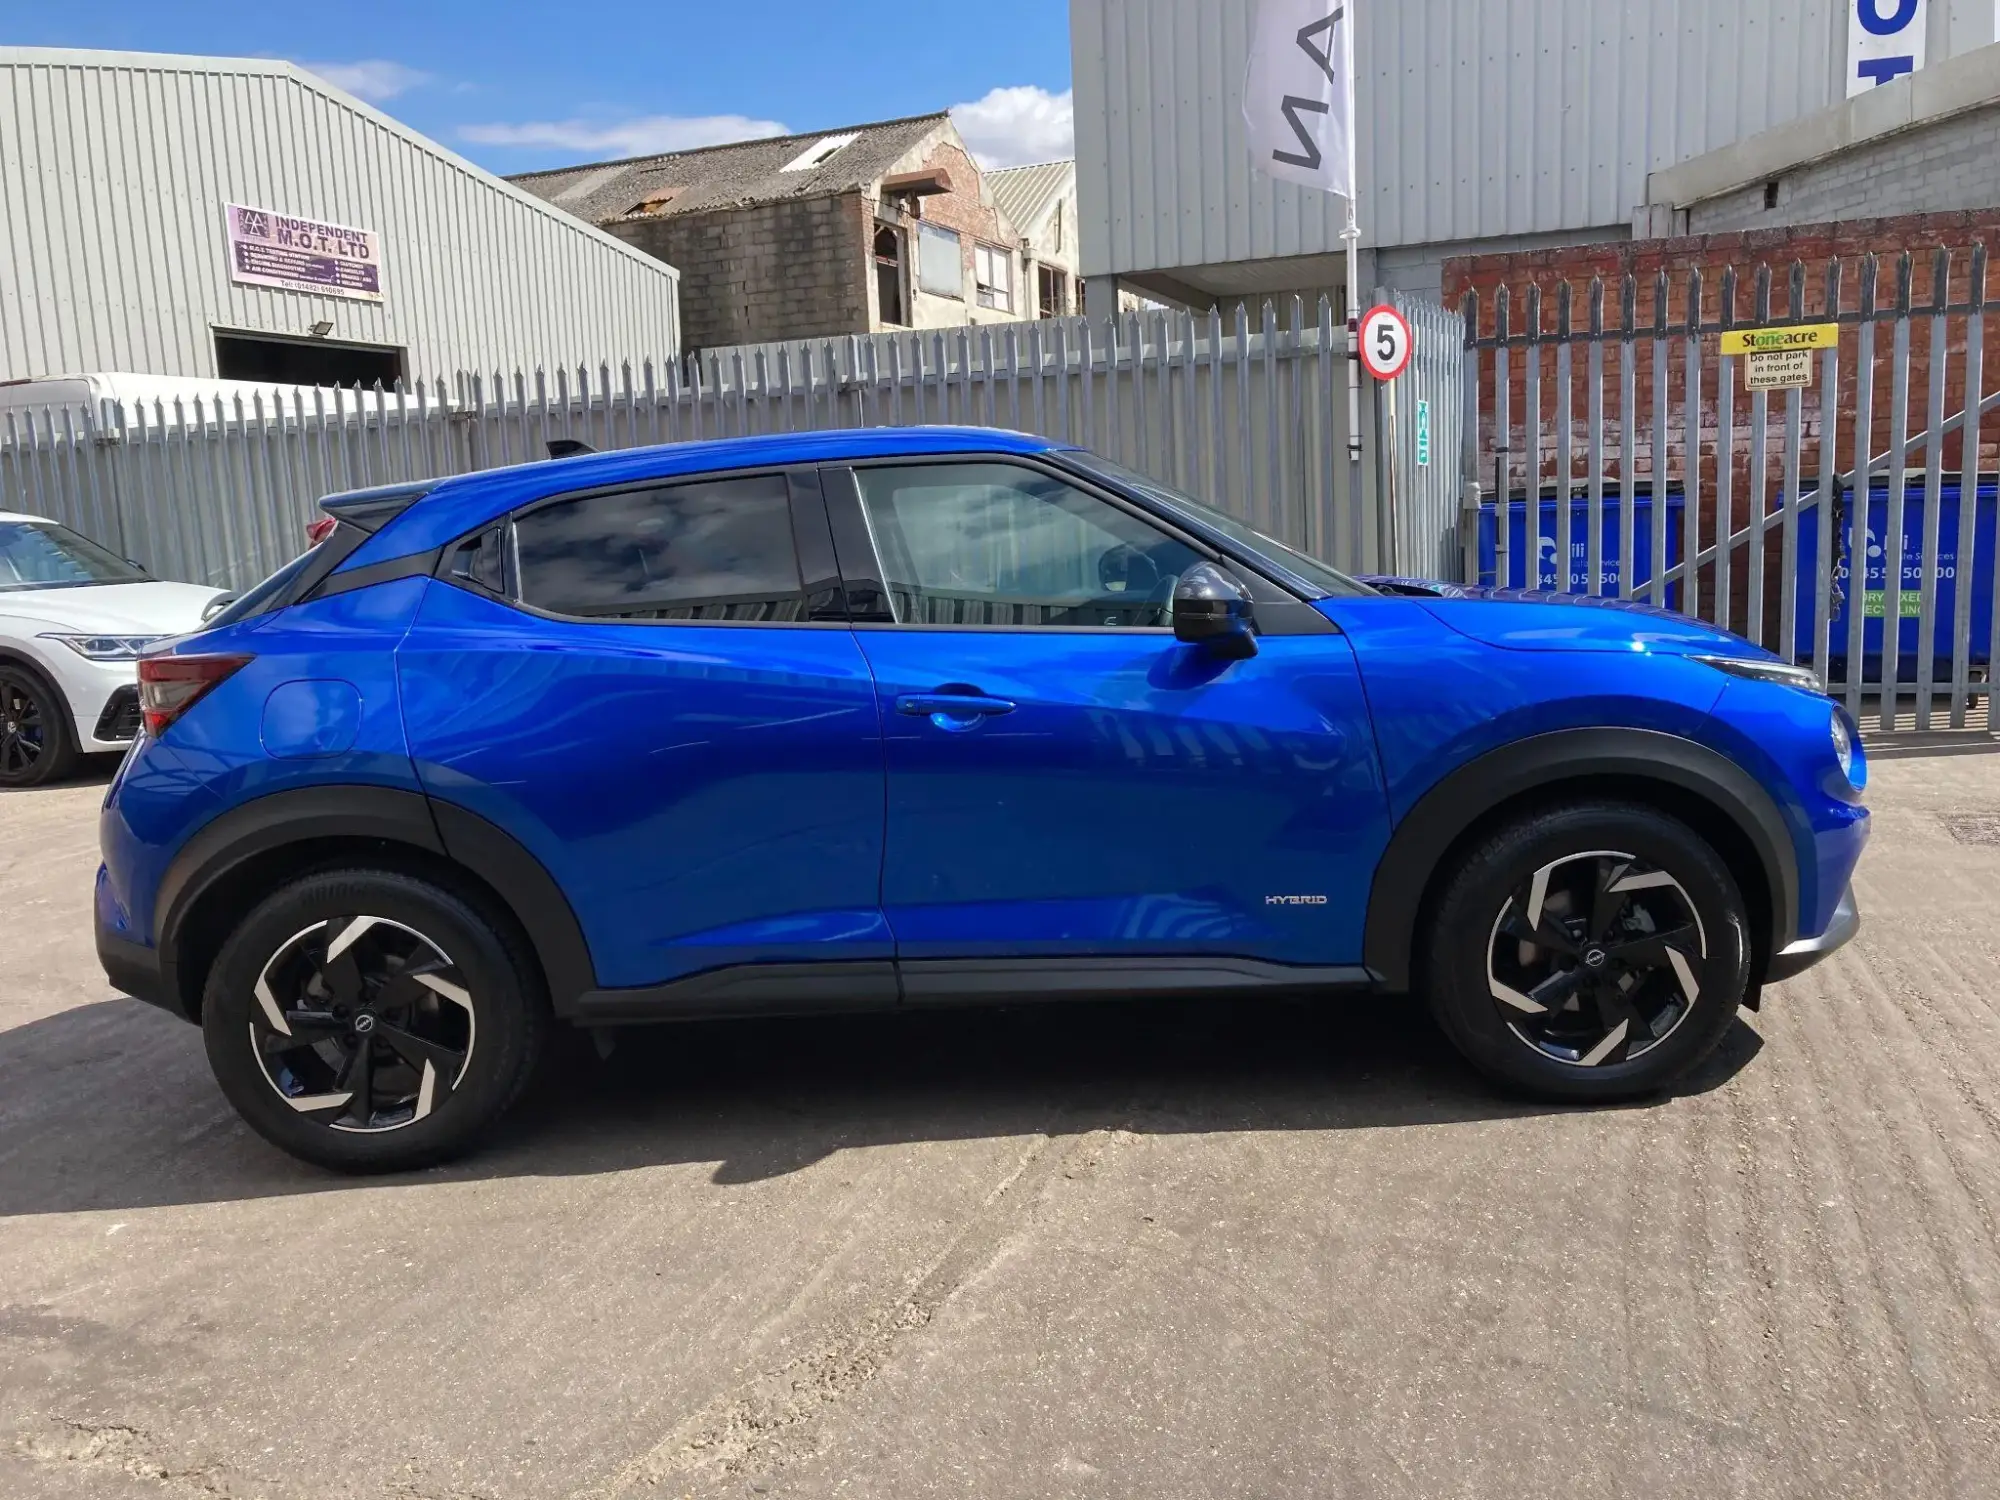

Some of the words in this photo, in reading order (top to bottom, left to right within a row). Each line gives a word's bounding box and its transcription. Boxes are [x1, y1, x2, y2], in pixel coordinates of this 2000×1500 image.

[275, 215, 368, 244] INDEPENDENT
[277, 228, 332, 253] M.O.T.
[337, 239, 370, 259] LTD
[1377, 324, 1396, 361] 5
[1742, 331, 1818, 347] Stoneacre
[1750, 353, 1764, 362] Do
[1767, 351, 1783, 361] not
[1785, 349, 1808, 361] park
[1755, 365, 1764, 373] in
[1766, 363, 1790, 372] front
[1793, 361, 1803, 370] of
[1750, 376, 1777, 384] these
[1780, 373, 1808, 384] gates
[1265, 895, 1328, 905] HYBRID
